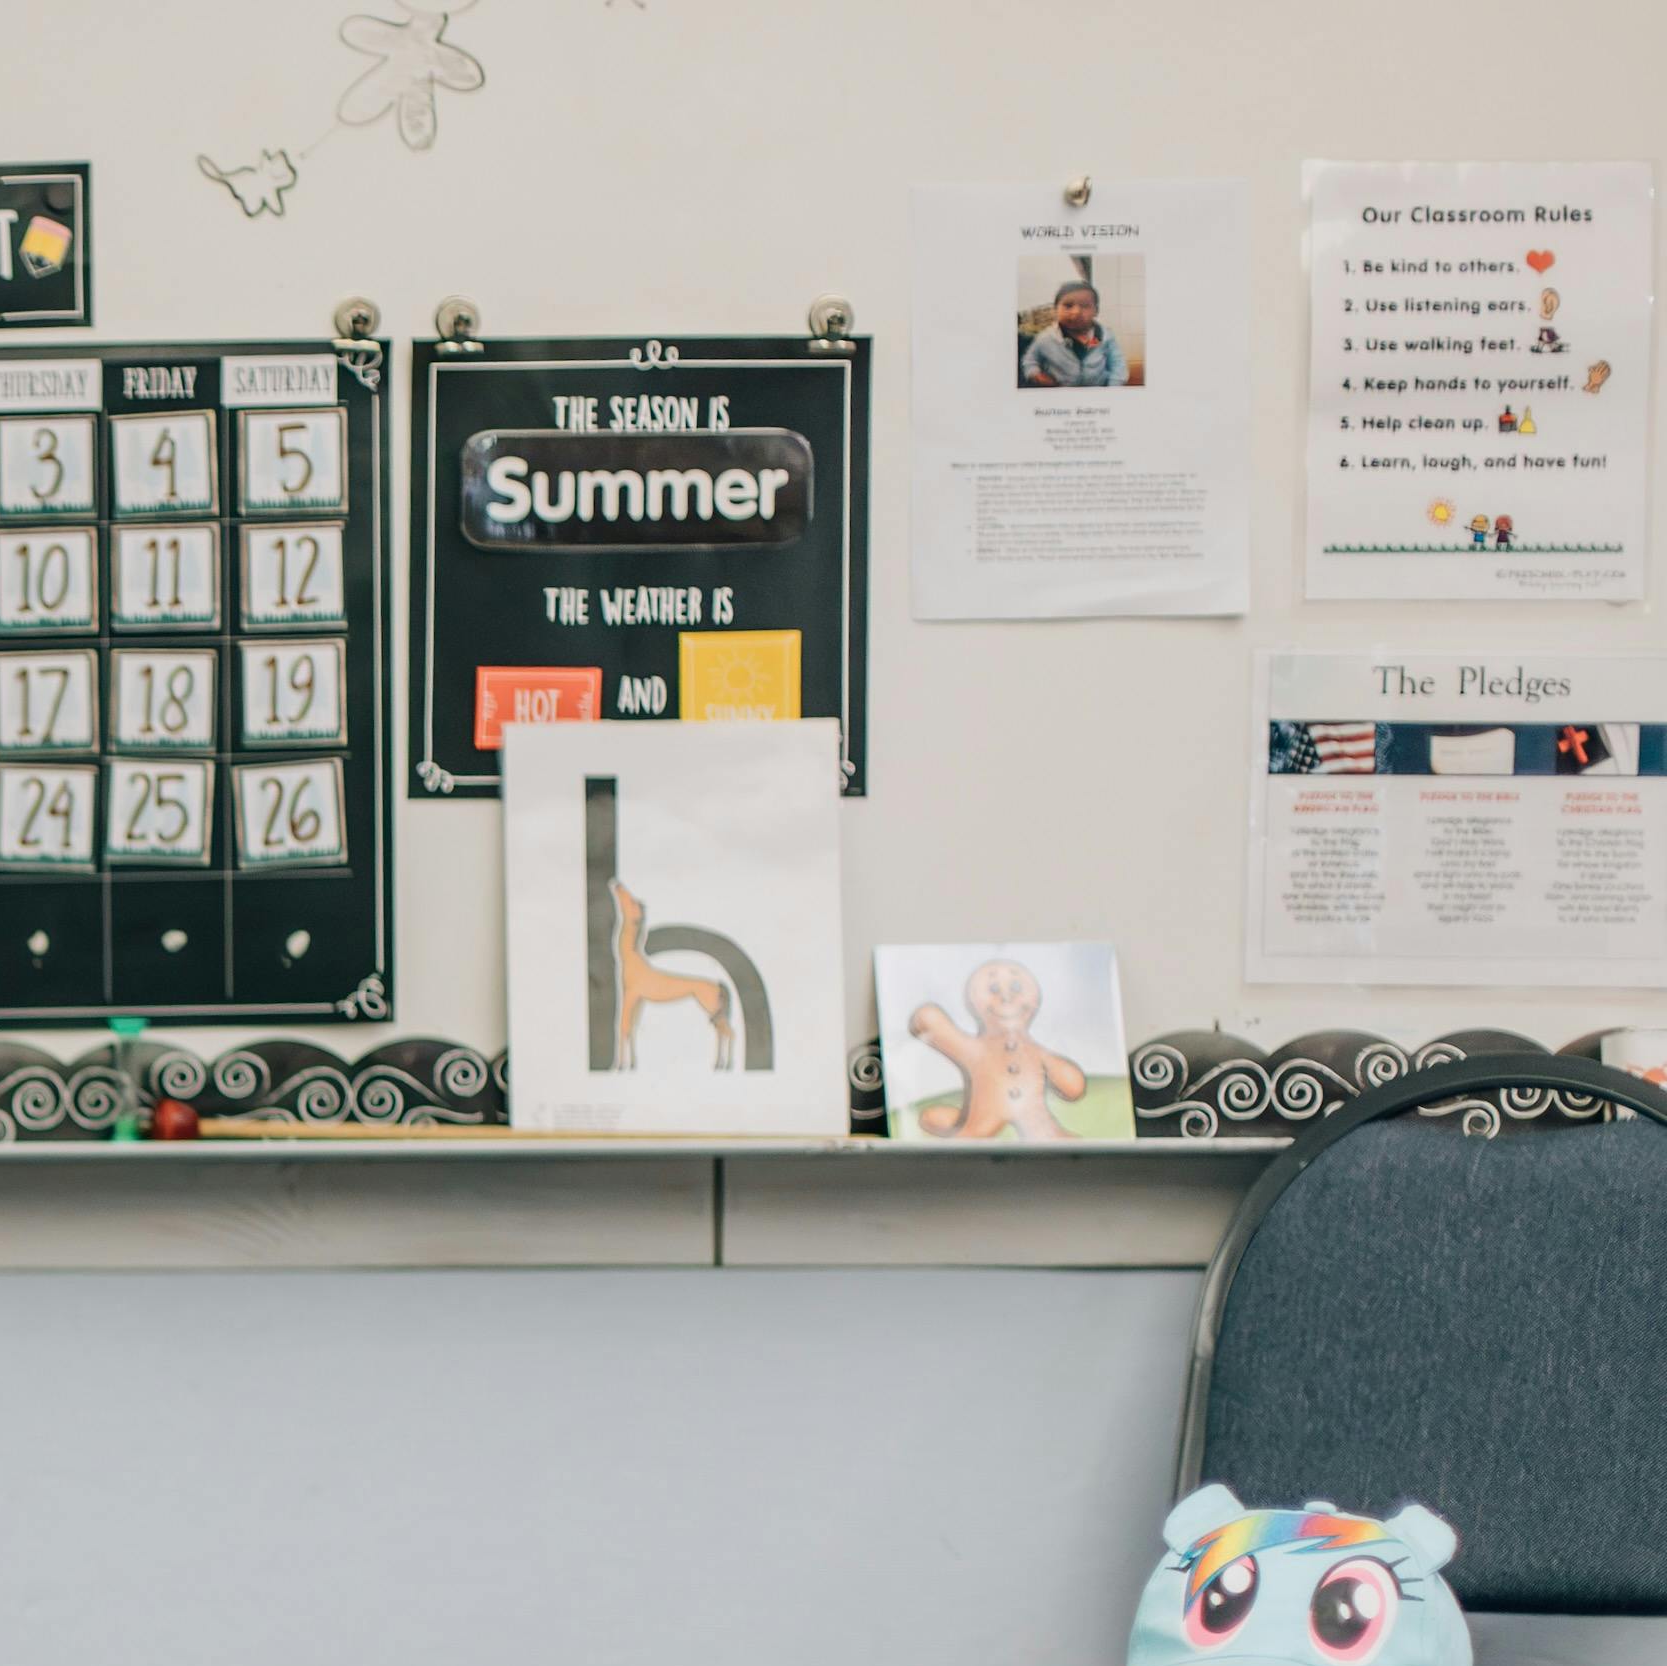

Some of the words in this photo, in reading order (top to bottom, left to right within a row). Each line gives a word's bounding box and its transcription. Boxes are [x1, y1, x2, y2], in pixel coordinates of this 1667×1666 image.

[1021, 225, 1075, 240] WORLD
[1080, 224, 1140, 239] VISION
[1362, 207, 1402, 224] Our
[1410, 206, 1526, 224] Classroom
[1534, 206, 1594, 223] Rules
[1343, 260, 1357, 274] 1.
[1363, 260, 1385, 274] Be
[1390, 260, 1428, 274] kind
[1434, 260, 1453, 274] to
[1459, 260, 1521, 274] others.
[1343, 300, 1359, 313] 2.
[1365, 299, 1398, 313] Use
[1404, 298, 1482, 316] listening
[1487, 300, 1532, 313] ears.
[1365, 338, 1398, 352] Use
[1405, 337, 1473, 355] walking
[1480, 337, 1522, 352] feet.
[122, 366, 198, 400] FRIDAY
[234, 364, 335, 396] SATURDAY
[1364, 378, 1408, 395] Keep
[1414, 377, 1466, 392] hands
[1474, 378, 1492, 391] to
[1497, 376, 1575, 395] yourself.
[552, 395, 599, 433] THE
[608, 394, 700, 433] SEASON
[708, 395, 731, 433] IS
[1362, 416, 1402, 432] Help
[1408, 416, 1455, 430] clean
[1462, 417, 1490, 432] up.
[30, 428, 65, 500] 3
[150, 426, 179, 498] 4
[275, 422, 314, 495] 5
[1361, 455, 1416, 471] Learn,
[1422, 455, 1478, 472] laugh,
[1484, 455, 1517, 470] and
[1524, 455, 1566, 470] have
[1572, 455, 1607, 470] fun!
[485, 455, 791, 524] Summer
[16, 543, 70, 613] 10
[144, 538, 182, 608] 11
[272, 535, 322, 608] 12
[543, 586, 590, 625] THE
[599, 586, 703, 626] WEATHER
[711, 586, 735, 626] IS
[15, 667, 69, 743] 17
[140, 664, 195, 734] 18
[265, 654, 316, 724] 19
[617, 674, 668, 716] AND
[1373, 665, 1436, 697] The
[1459, 665, 1572, 703] Pledges
[513, 687, 563, 722] HOT
[20, 777, 75, 848] 24
[126, 771, 189, 843] 25
[260, 776, 322, 848] 26
